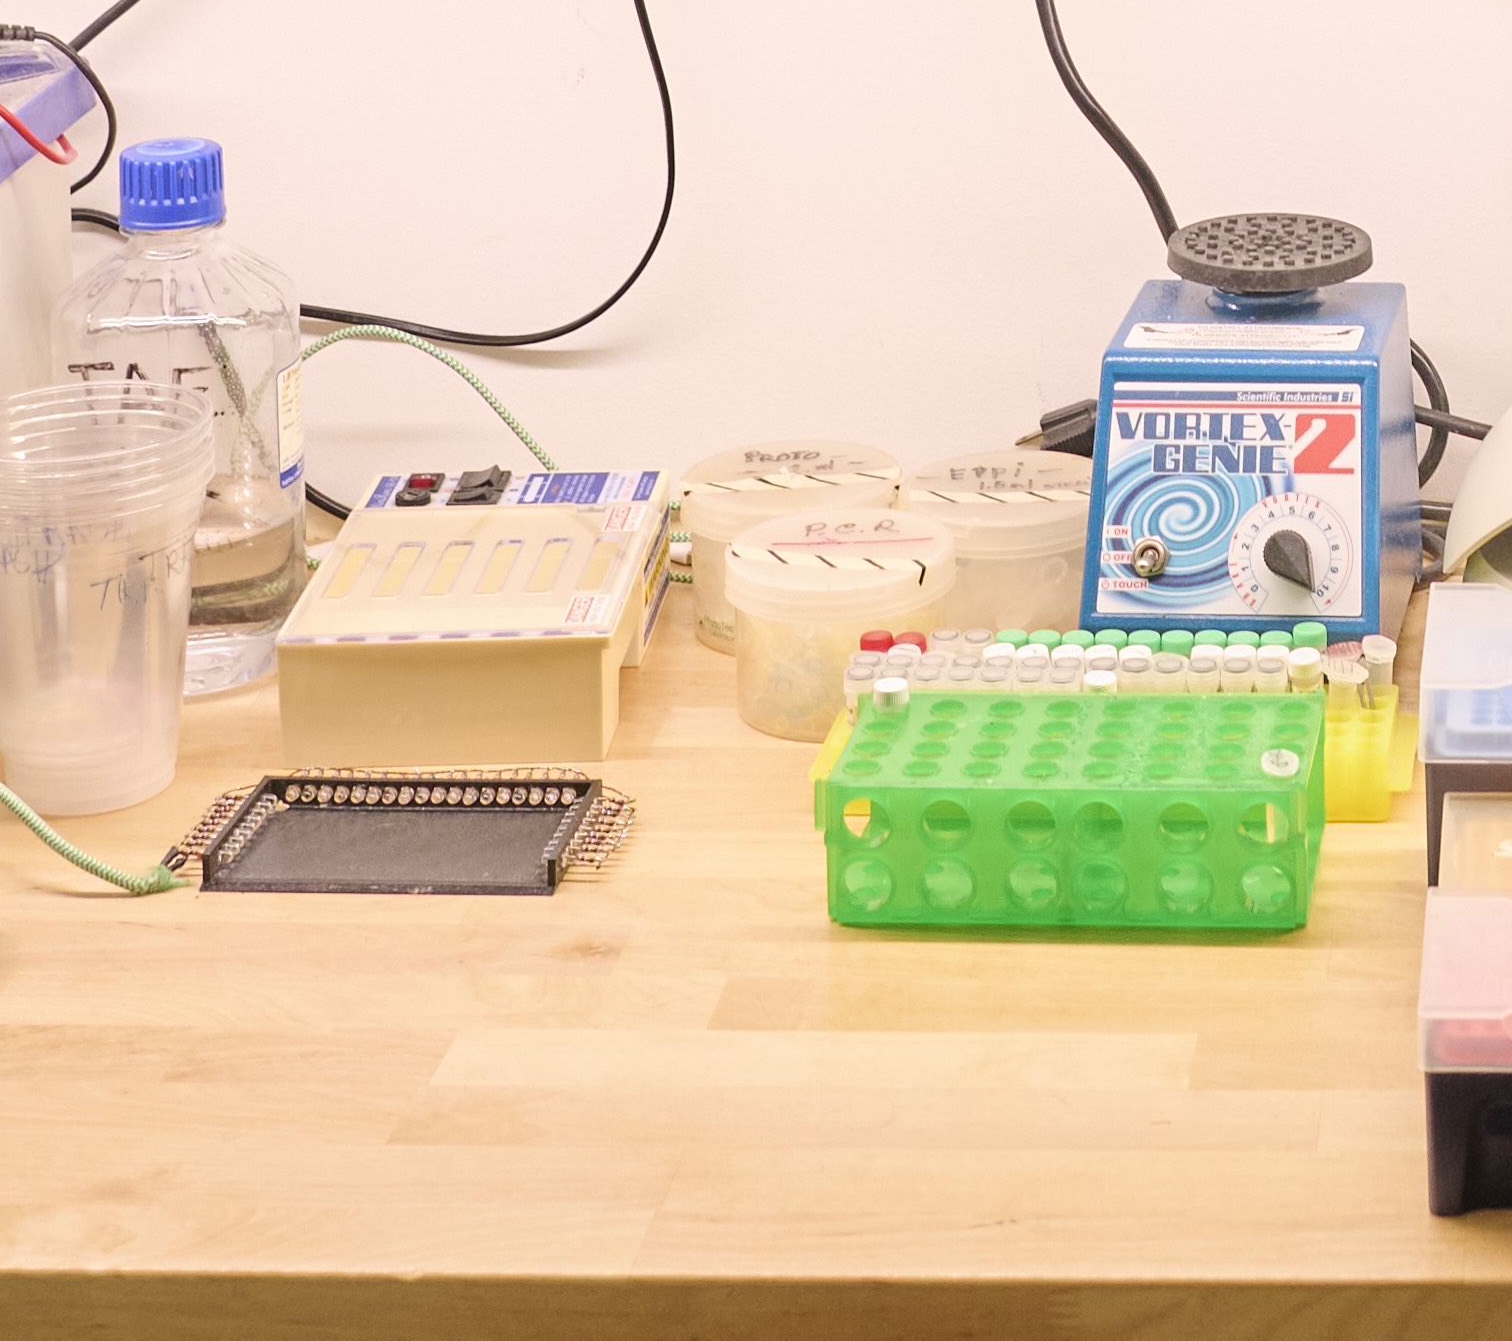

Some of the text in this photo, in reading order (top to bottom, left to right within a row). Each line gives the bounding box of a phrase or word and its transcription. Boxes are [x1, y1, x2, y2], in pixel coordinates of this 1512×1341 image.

[1237, 391, 1333, 402] Scientific Industries
[1294, 413, 1356, 474] 2
[744, 451, 819, 463] PROTO
[1153, 444, 1287, 474] GENIE
[1113, 581, 1147, 589] TOUCH
